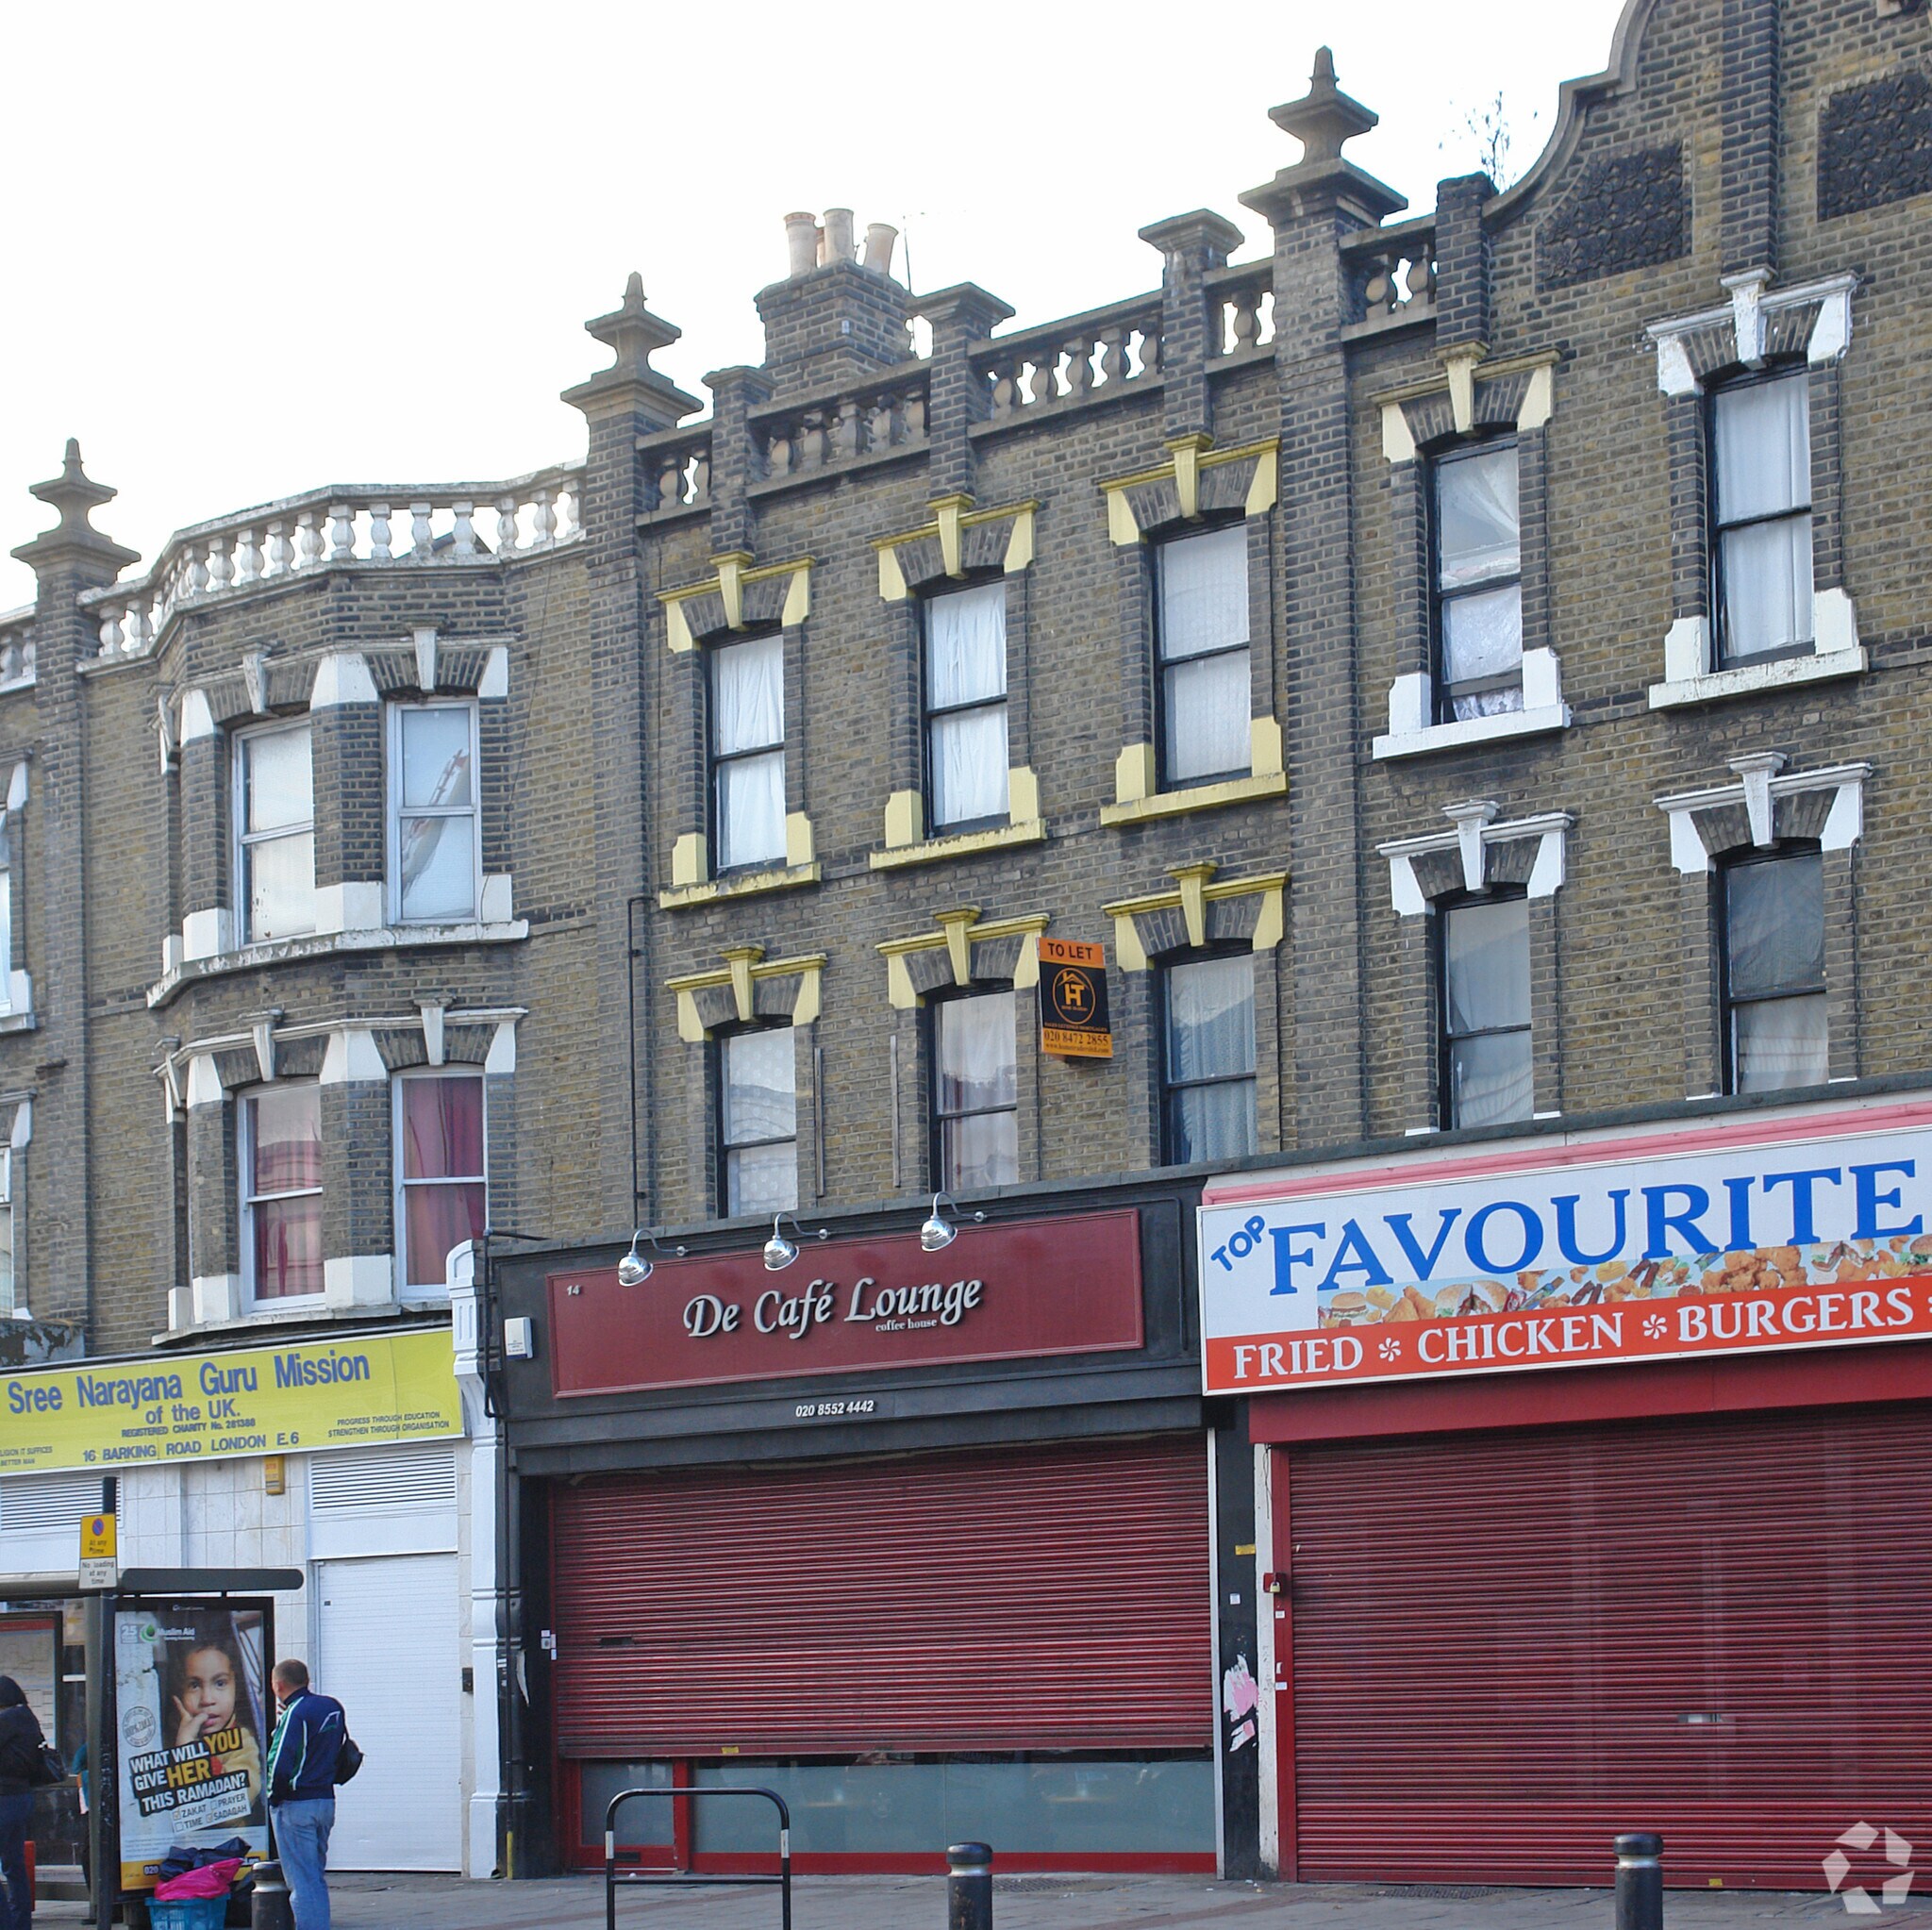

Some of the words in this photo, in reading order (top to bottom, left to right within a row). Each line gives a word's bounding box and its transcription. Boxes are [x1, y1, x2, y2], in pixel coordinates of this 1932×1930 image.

[1048, 943, 1064, 957] TO
[1069, 945, 1093, 960] LET
[1044, 1030, 1059, 1041] 020
[1062, 1032, 1083, 1044] 8472
[1087, 1035, 1108, 1046] 2855
[1269, 1158, 1924, 1296] FAVOURITE
[1210, 1214, 1265, 1273] TOP
[566, 1285, 581, 1296] 14
[683, 1294, 741, 1338] De
[754, 1279, 835, 1339] Café
[844, 1277, 982, 1325] Lounge
[875, 1319, 907, 1332] coffee
[908, 1318, 938, 1329] house
[1233, 1335, 1364, 1379] FRIED
[1418, 1311, 1624, 1364] CHICKEN
[1676, 1287, 1914, 1343] BURGERS
[8, 1381, 62, 1414] Sree
[76, 1374, 183, 1410] Narayana
[199, 1361, 258, 1397] Guru
[274, 1349, 370, 1389] Mission
[145, 1406, 163, 1424] of
[172, 1403, 201, 1422] the
[208, 1398, 241, 1420] UK.
[795, 1405, 815, 1417] 020
[817, 1402, 844, 1416] 8552
[846, 1400, 874, 1413] 4442
[337, 1416, 371, 1426] PROGRESS
[373, 1414, 403, 1423] THROUGH
[404, 1411, 441, 1421] EDUCATION
[121, 1426, 169, 1438] REGISTERED
[173, 1423, 207, 1434] CHARITY
[328, 1427, 369, 1438] STRENGTHEN
[371, 1423, 400, 1433] THROUGH
[402, 1421, 450, 1432] ORGANISATION
[83, 1450, 96, 1462] 16
[103, 1444, 158, 1461] BARKING
[166, 1440, 202, 1456] ROAD
[211, 1434, 266, 1452] LONDON
[121, 1625, 138, 1636] 25
[183, 1627, 195, 1636] Aid
[130, 1750, 170, 1773] WHAT
[171, 1742, 209, 1763] WILL
[204, 1728, 241, 1755] YOU
[134, 1770, 167, 1791] GIVE
[166, 1758, 211, 1788] HER
[142, 1791, 175, 1812] THIS
[176, 1772, 246, 1804] RAMADAN?
[218, 1793, 246, 1807] PRAYER
[182, 1805, 206, 1818] ZAKAT
[214, 1805, 247, 1821] SADAQAH
[184, 1818, 203, 1829] TIME
[143, 1865, 158, 1874] 020
